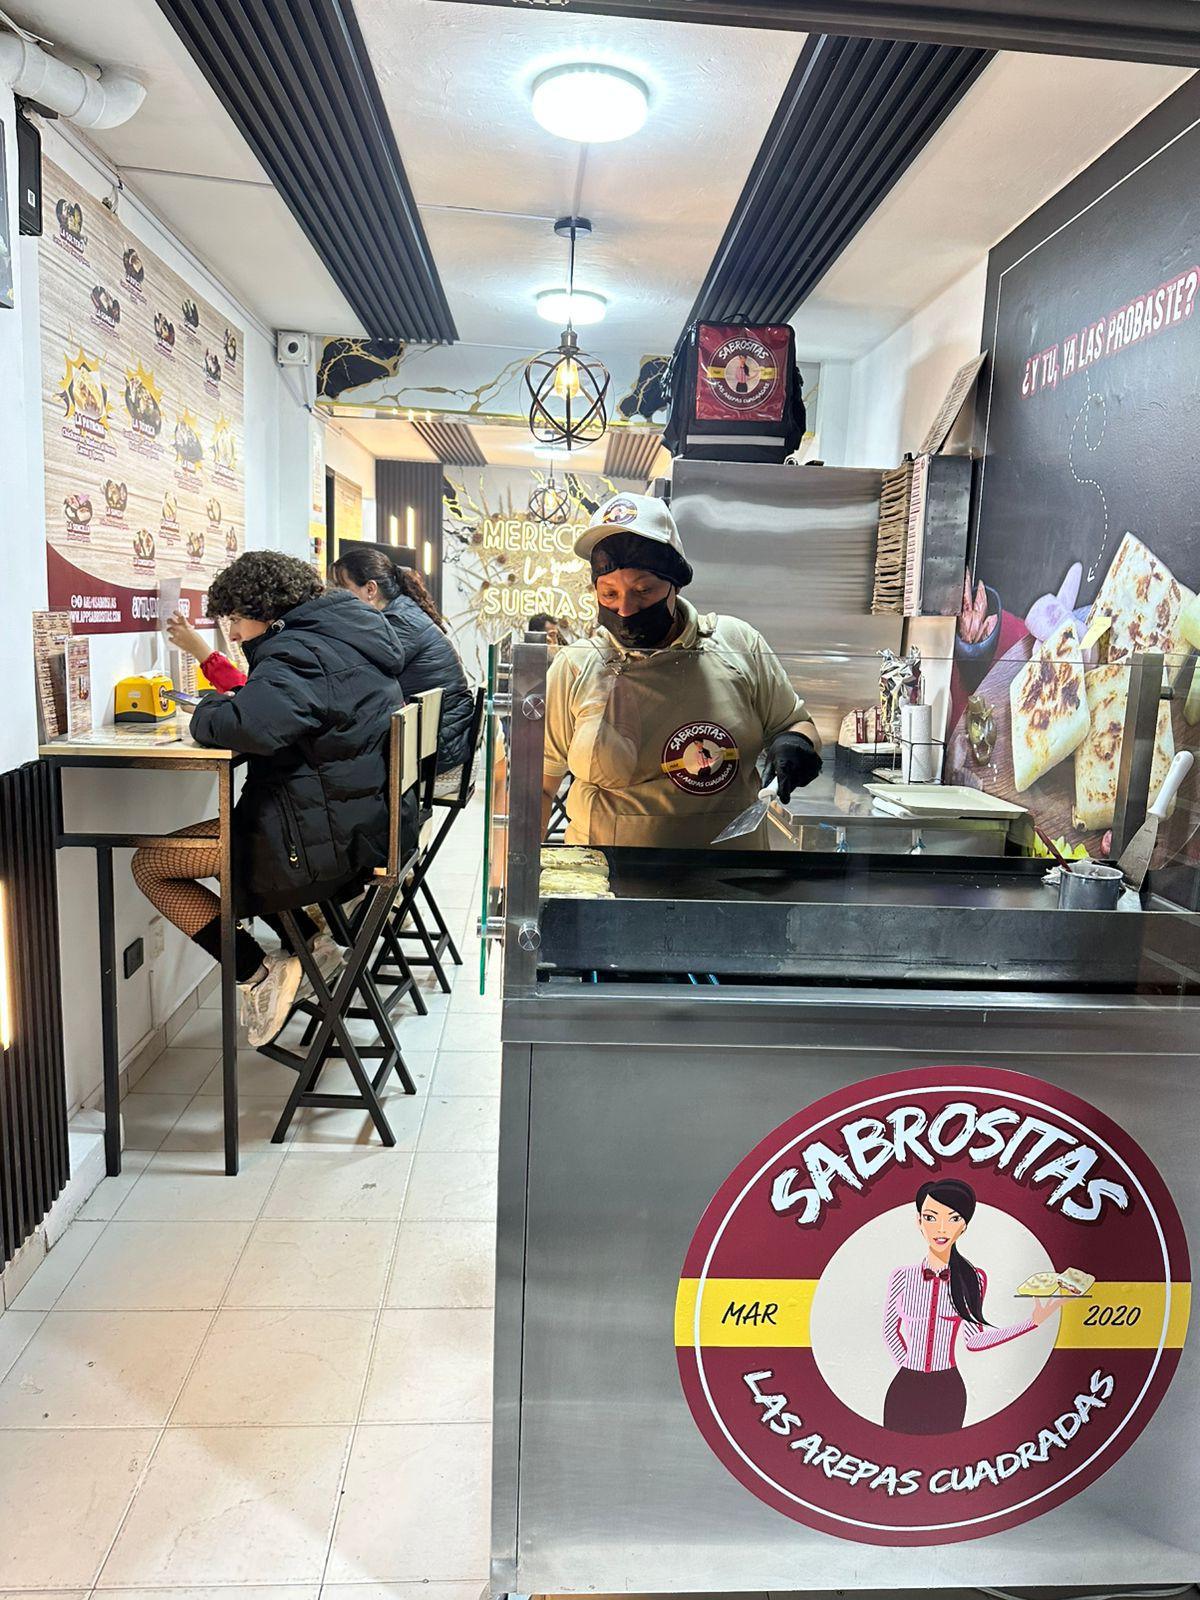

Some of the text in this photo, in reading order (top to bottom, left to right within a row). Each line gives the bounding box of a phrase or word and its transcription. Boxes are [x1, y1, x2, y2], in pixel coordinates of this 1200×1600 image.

[718, 339, 769, 360] SABROSITAS
[1022, 359, 1039, 395] ¿Y
[1063, 339, 1076, 375] YA
[1078, 322, 1104, 368] LAS
[1106, 271, 1198, 354] PROBASTE?
[670, 725, 726, 751] SABROSITAS
[770, 1101, 1130, 1224] SABROSITAS
[721, 1301, 1142, 1327] MAR 2020
[743, 1369, 1115, 1497] LAS AREPAS CUADRADAS
